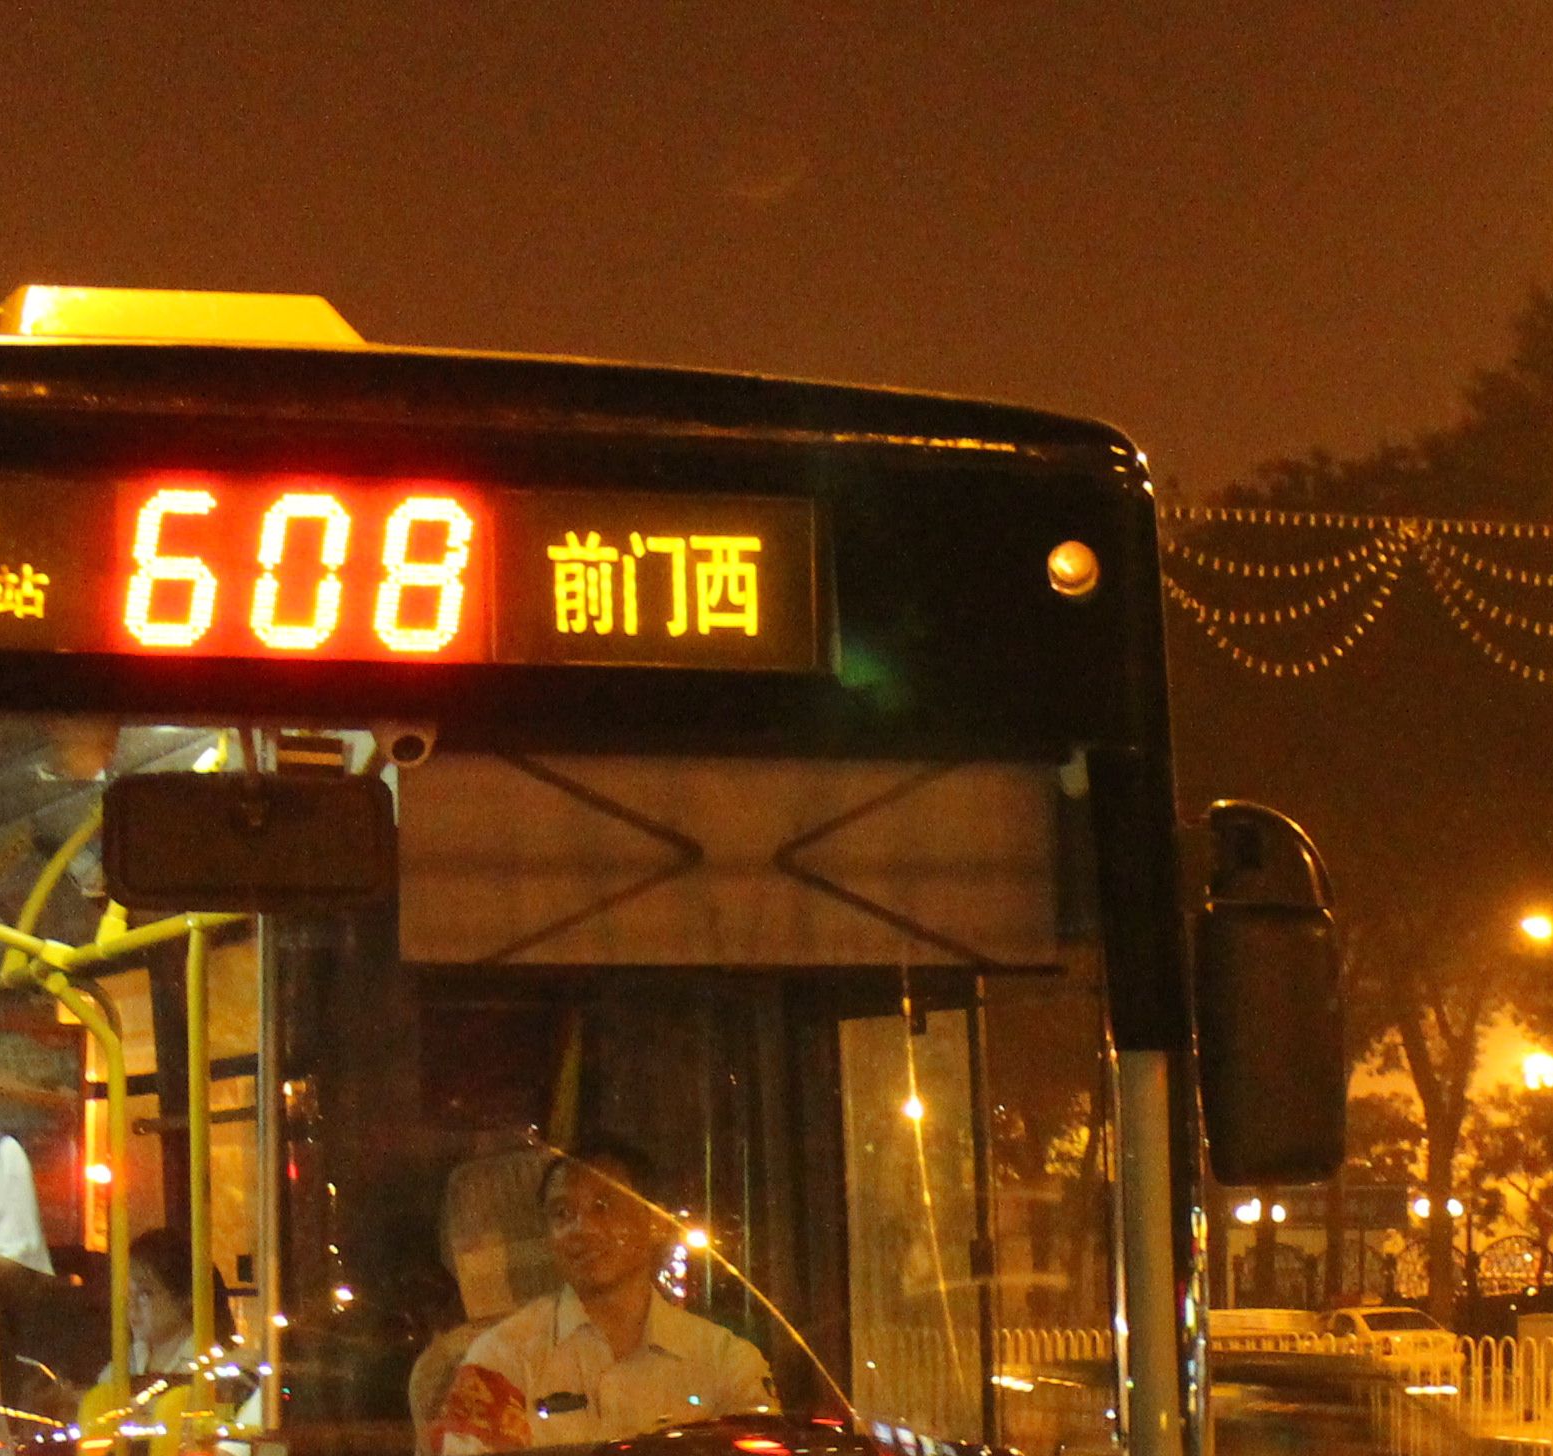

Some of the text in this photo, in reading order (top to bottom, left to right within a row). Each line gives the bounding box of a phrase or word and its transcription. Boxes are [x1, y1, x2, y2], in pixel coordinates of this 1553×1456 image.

[124, 489, 473, 651] 608
[547, 531, 761, 637] 前门西
